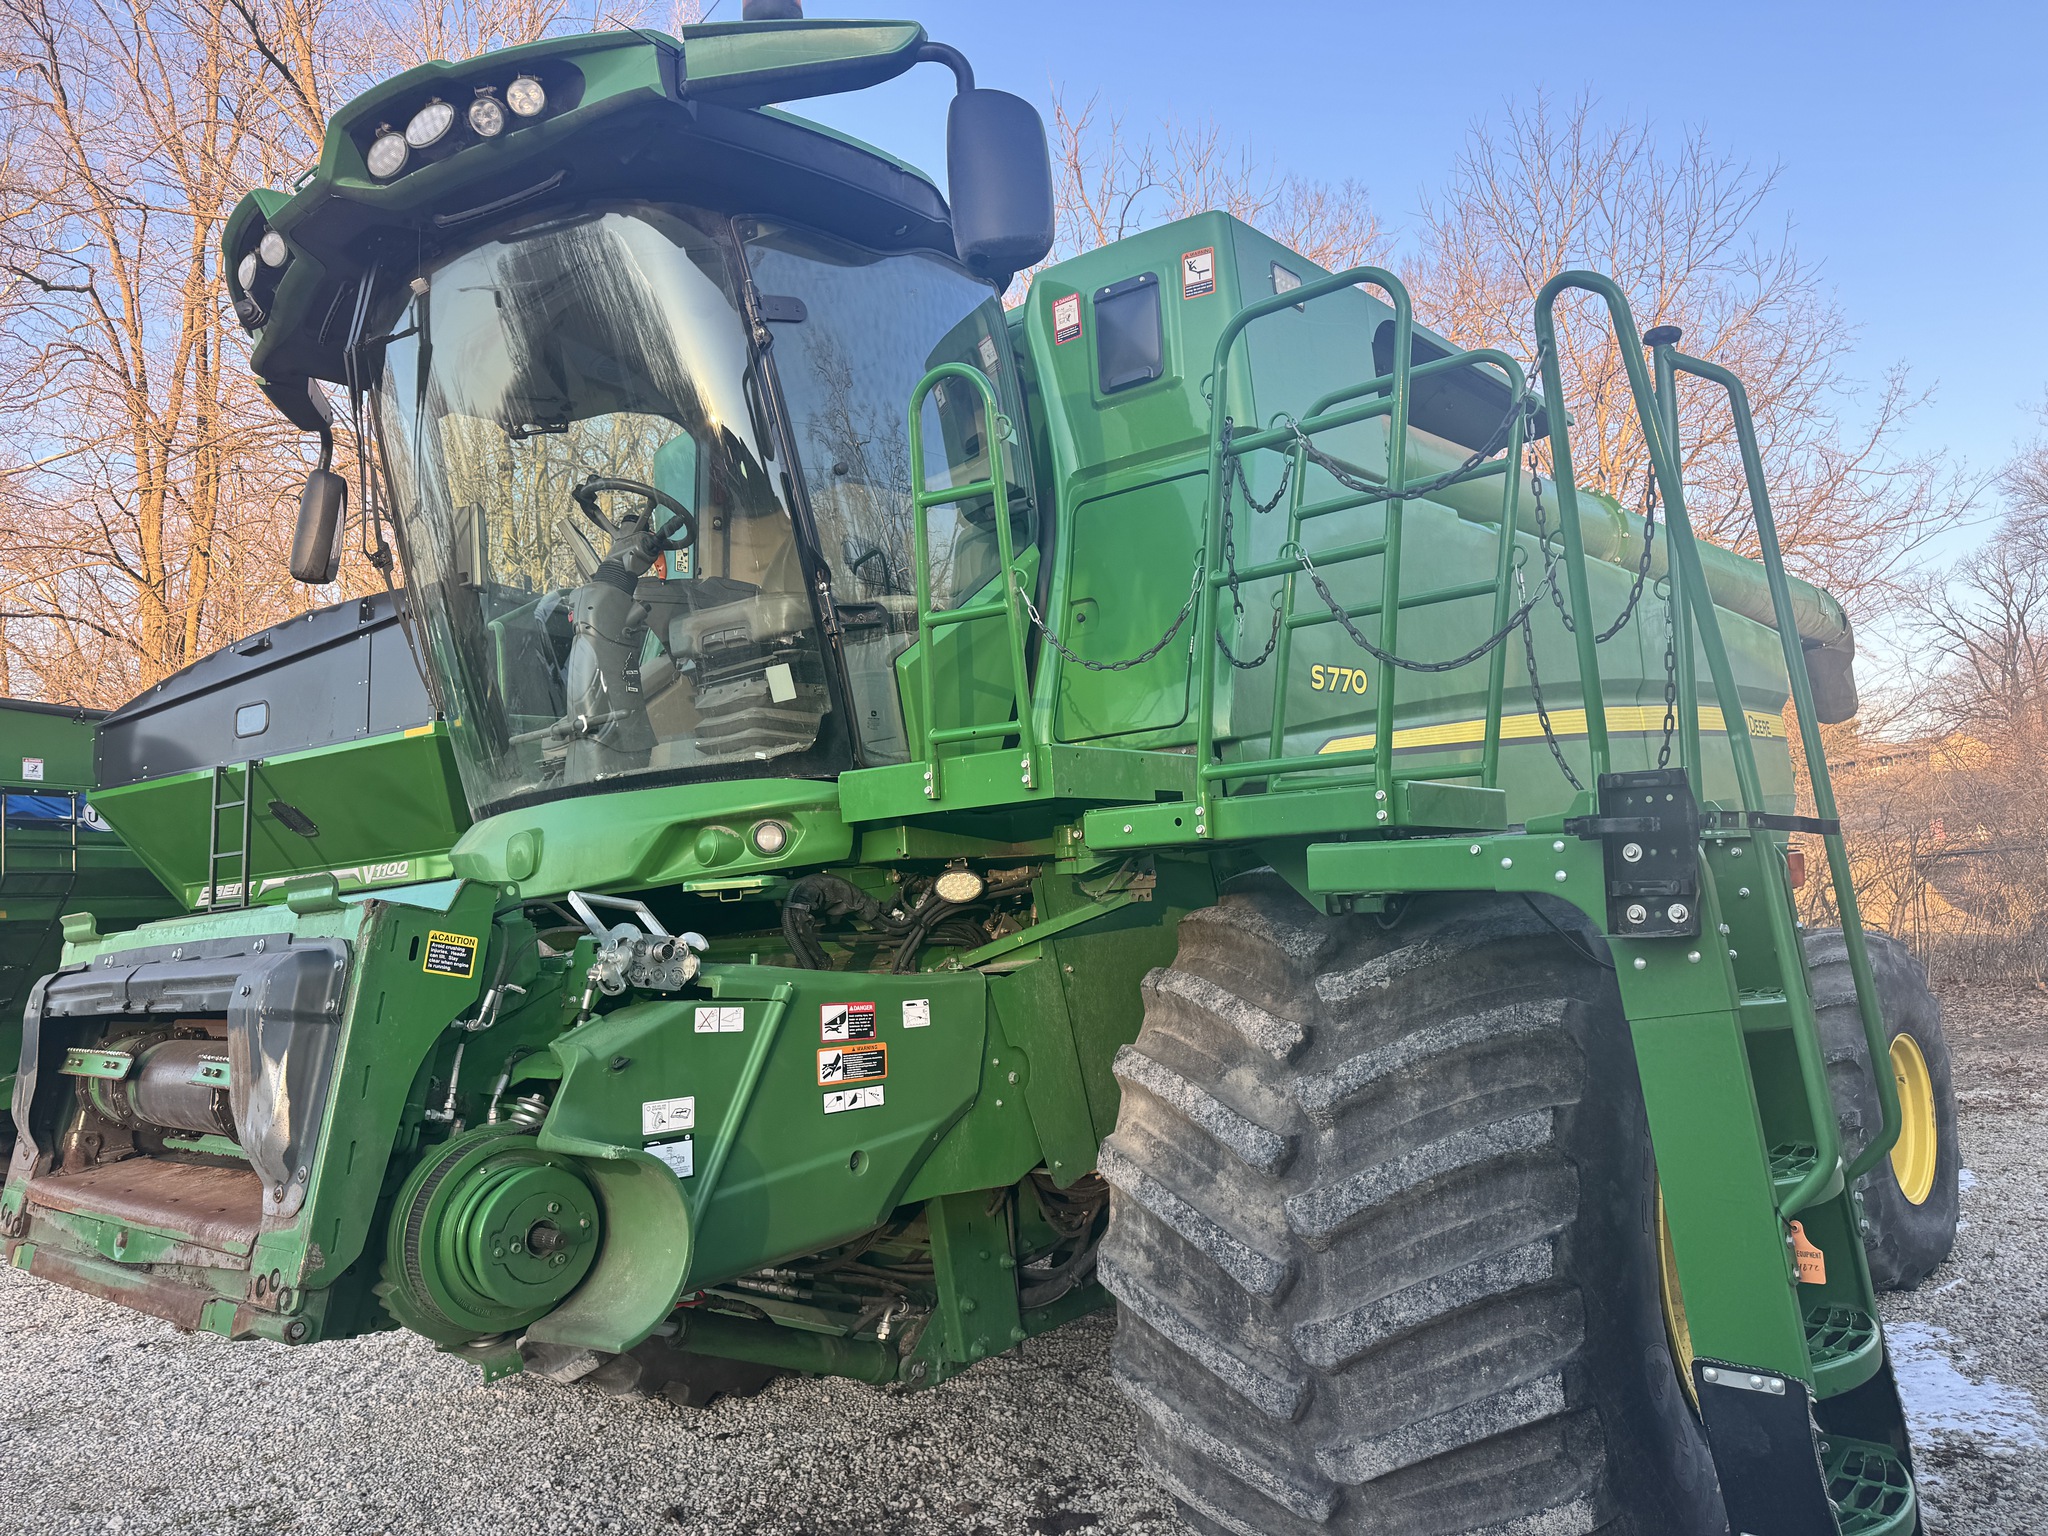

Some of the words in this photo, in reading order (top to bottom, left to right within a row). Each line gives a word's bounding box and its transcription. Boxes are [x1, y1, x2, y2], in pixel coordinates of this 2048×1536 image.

[1311, 664, 1368, 695] S770
[1748, 715, 1772, 735] DEERE
[363, 861, 409, 884] V1100
[438, 933, 475, 945] CAUTION
[1797, 1250, 1821, 1259] EQUIPMENT
